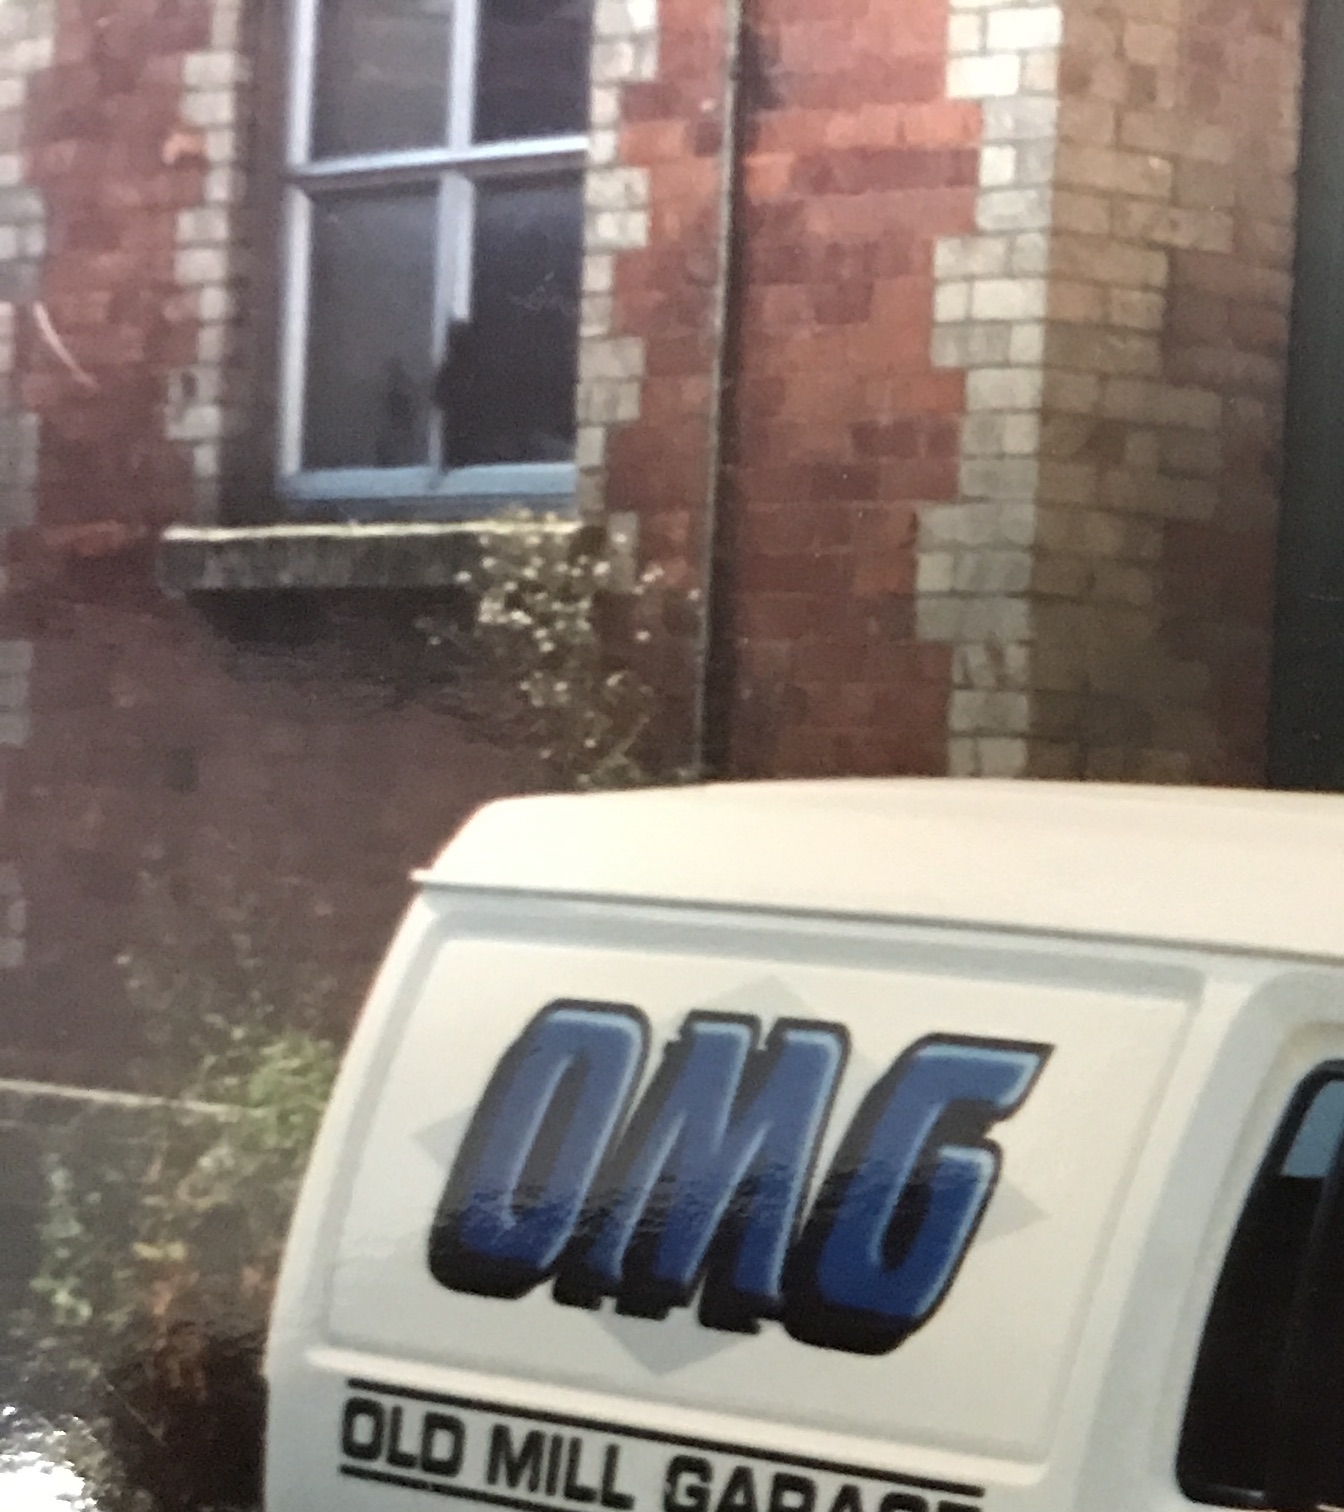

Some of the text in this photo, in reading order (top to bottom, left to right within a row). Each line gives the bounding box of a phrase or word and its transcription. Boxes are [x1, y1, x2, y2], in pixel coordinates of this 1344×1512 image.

[427, 997, 1056, 1355] OMG
[341, 1397, 466, 1477] OLD
[486, 1424, 635, 1511] MILL
